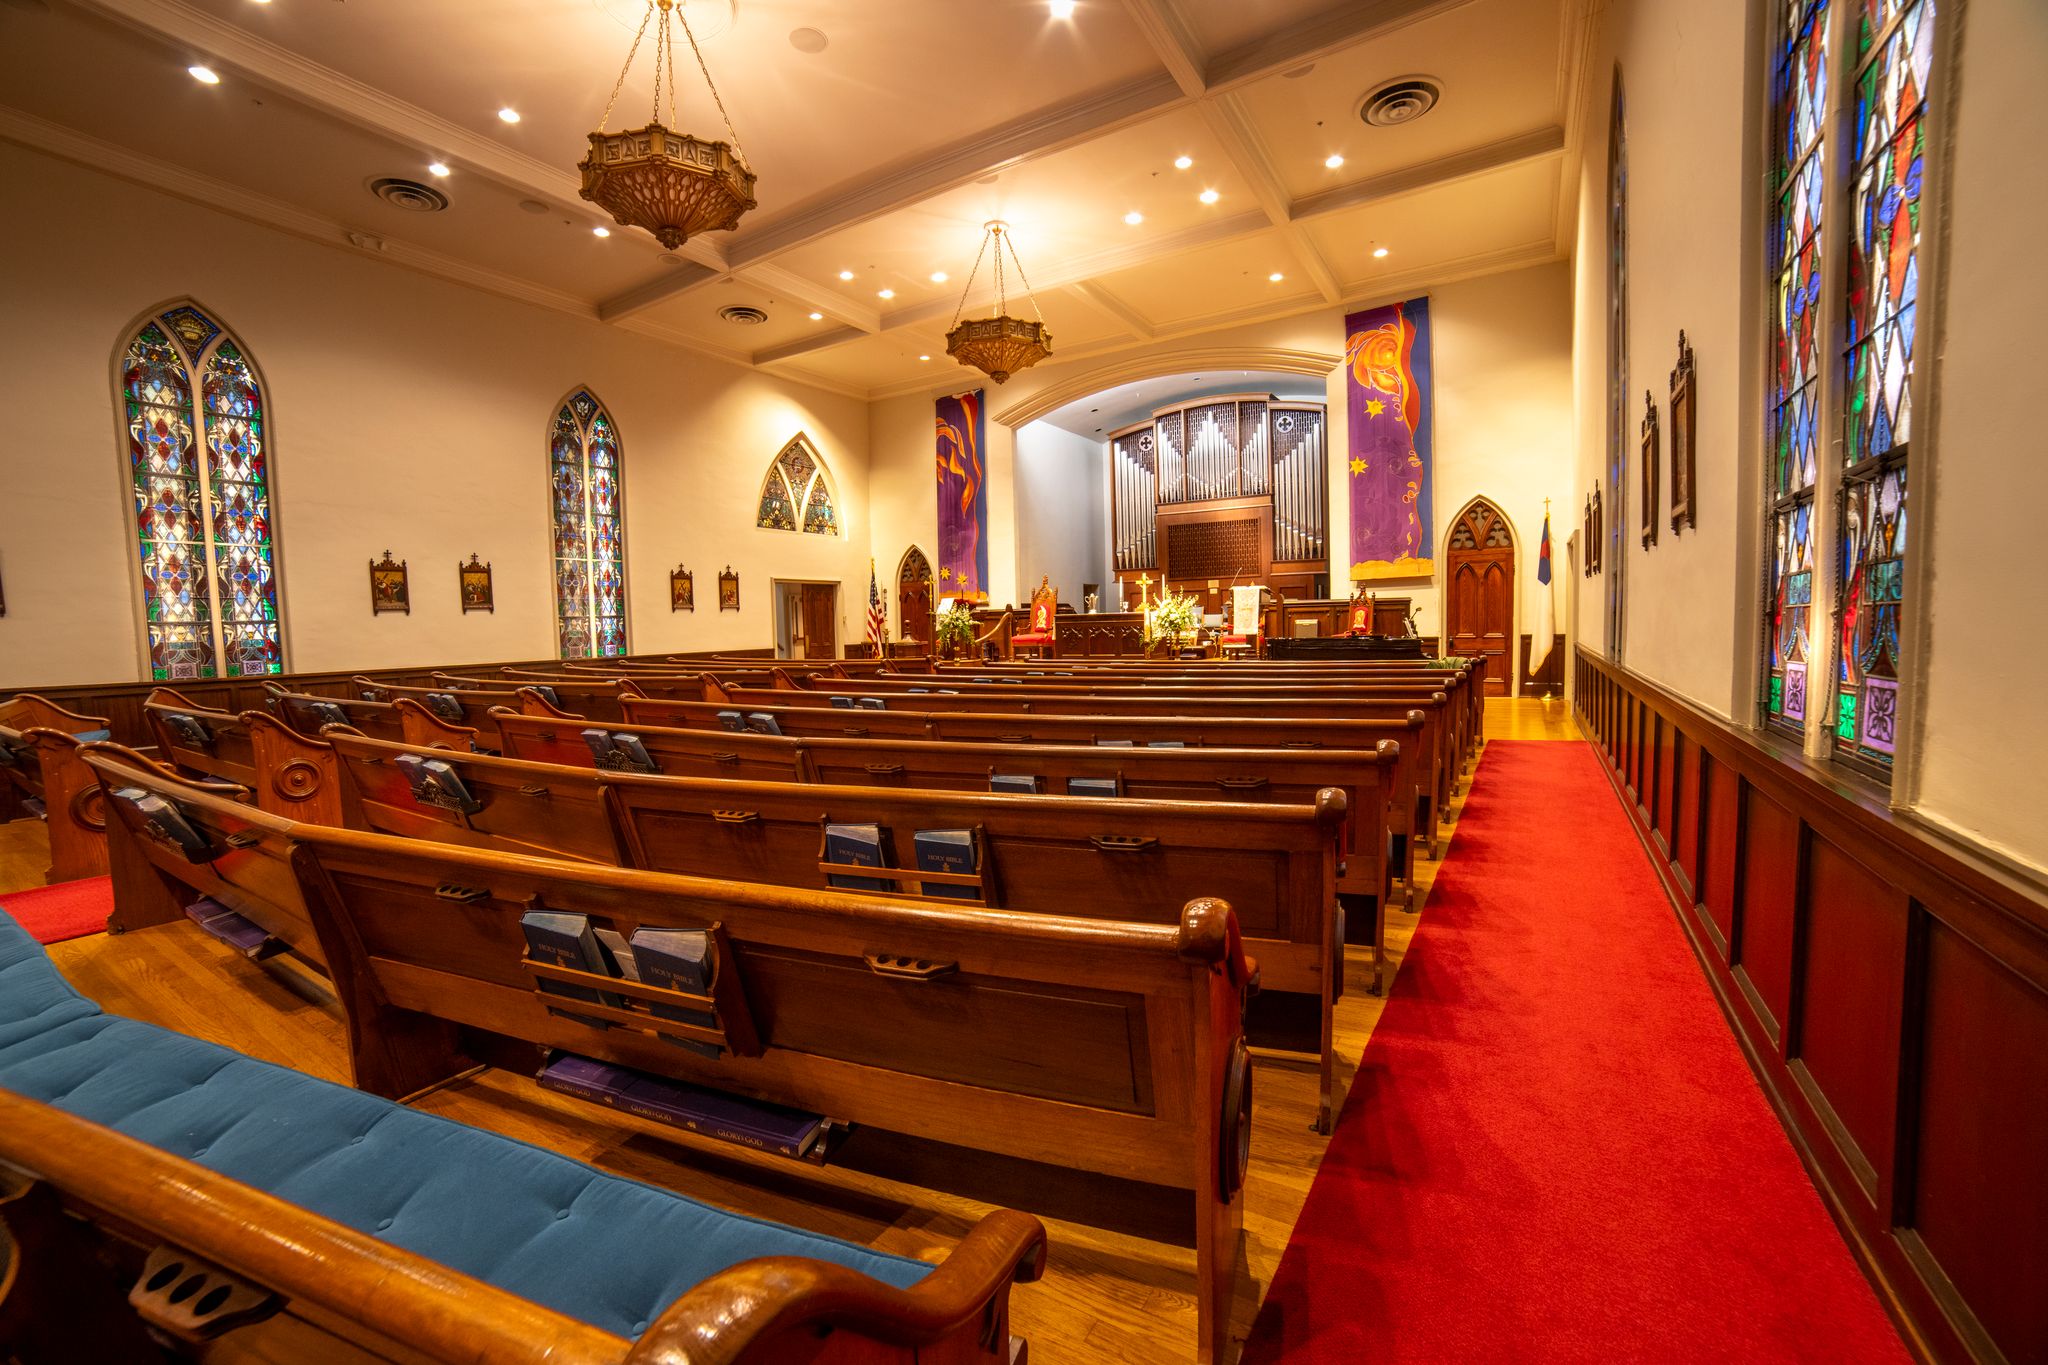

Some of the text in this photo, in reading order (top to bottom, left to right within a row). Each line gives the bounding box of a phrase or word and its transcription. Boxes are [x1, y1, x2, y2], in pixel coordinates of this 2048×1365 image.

[838, 849, 871, 861] HOLY BIBLE
[927, 854, 963, 864] HOLY BIBLE
[538, 943, 576, 960] HOLY BIBLE
[650, 966, 695, 985] HOLY BIBLE
[655, 1111, 672, 1122] GOD
[717, 1128, 740, 1141] GLORY
[744, 1136, 763, 1147] GOD
